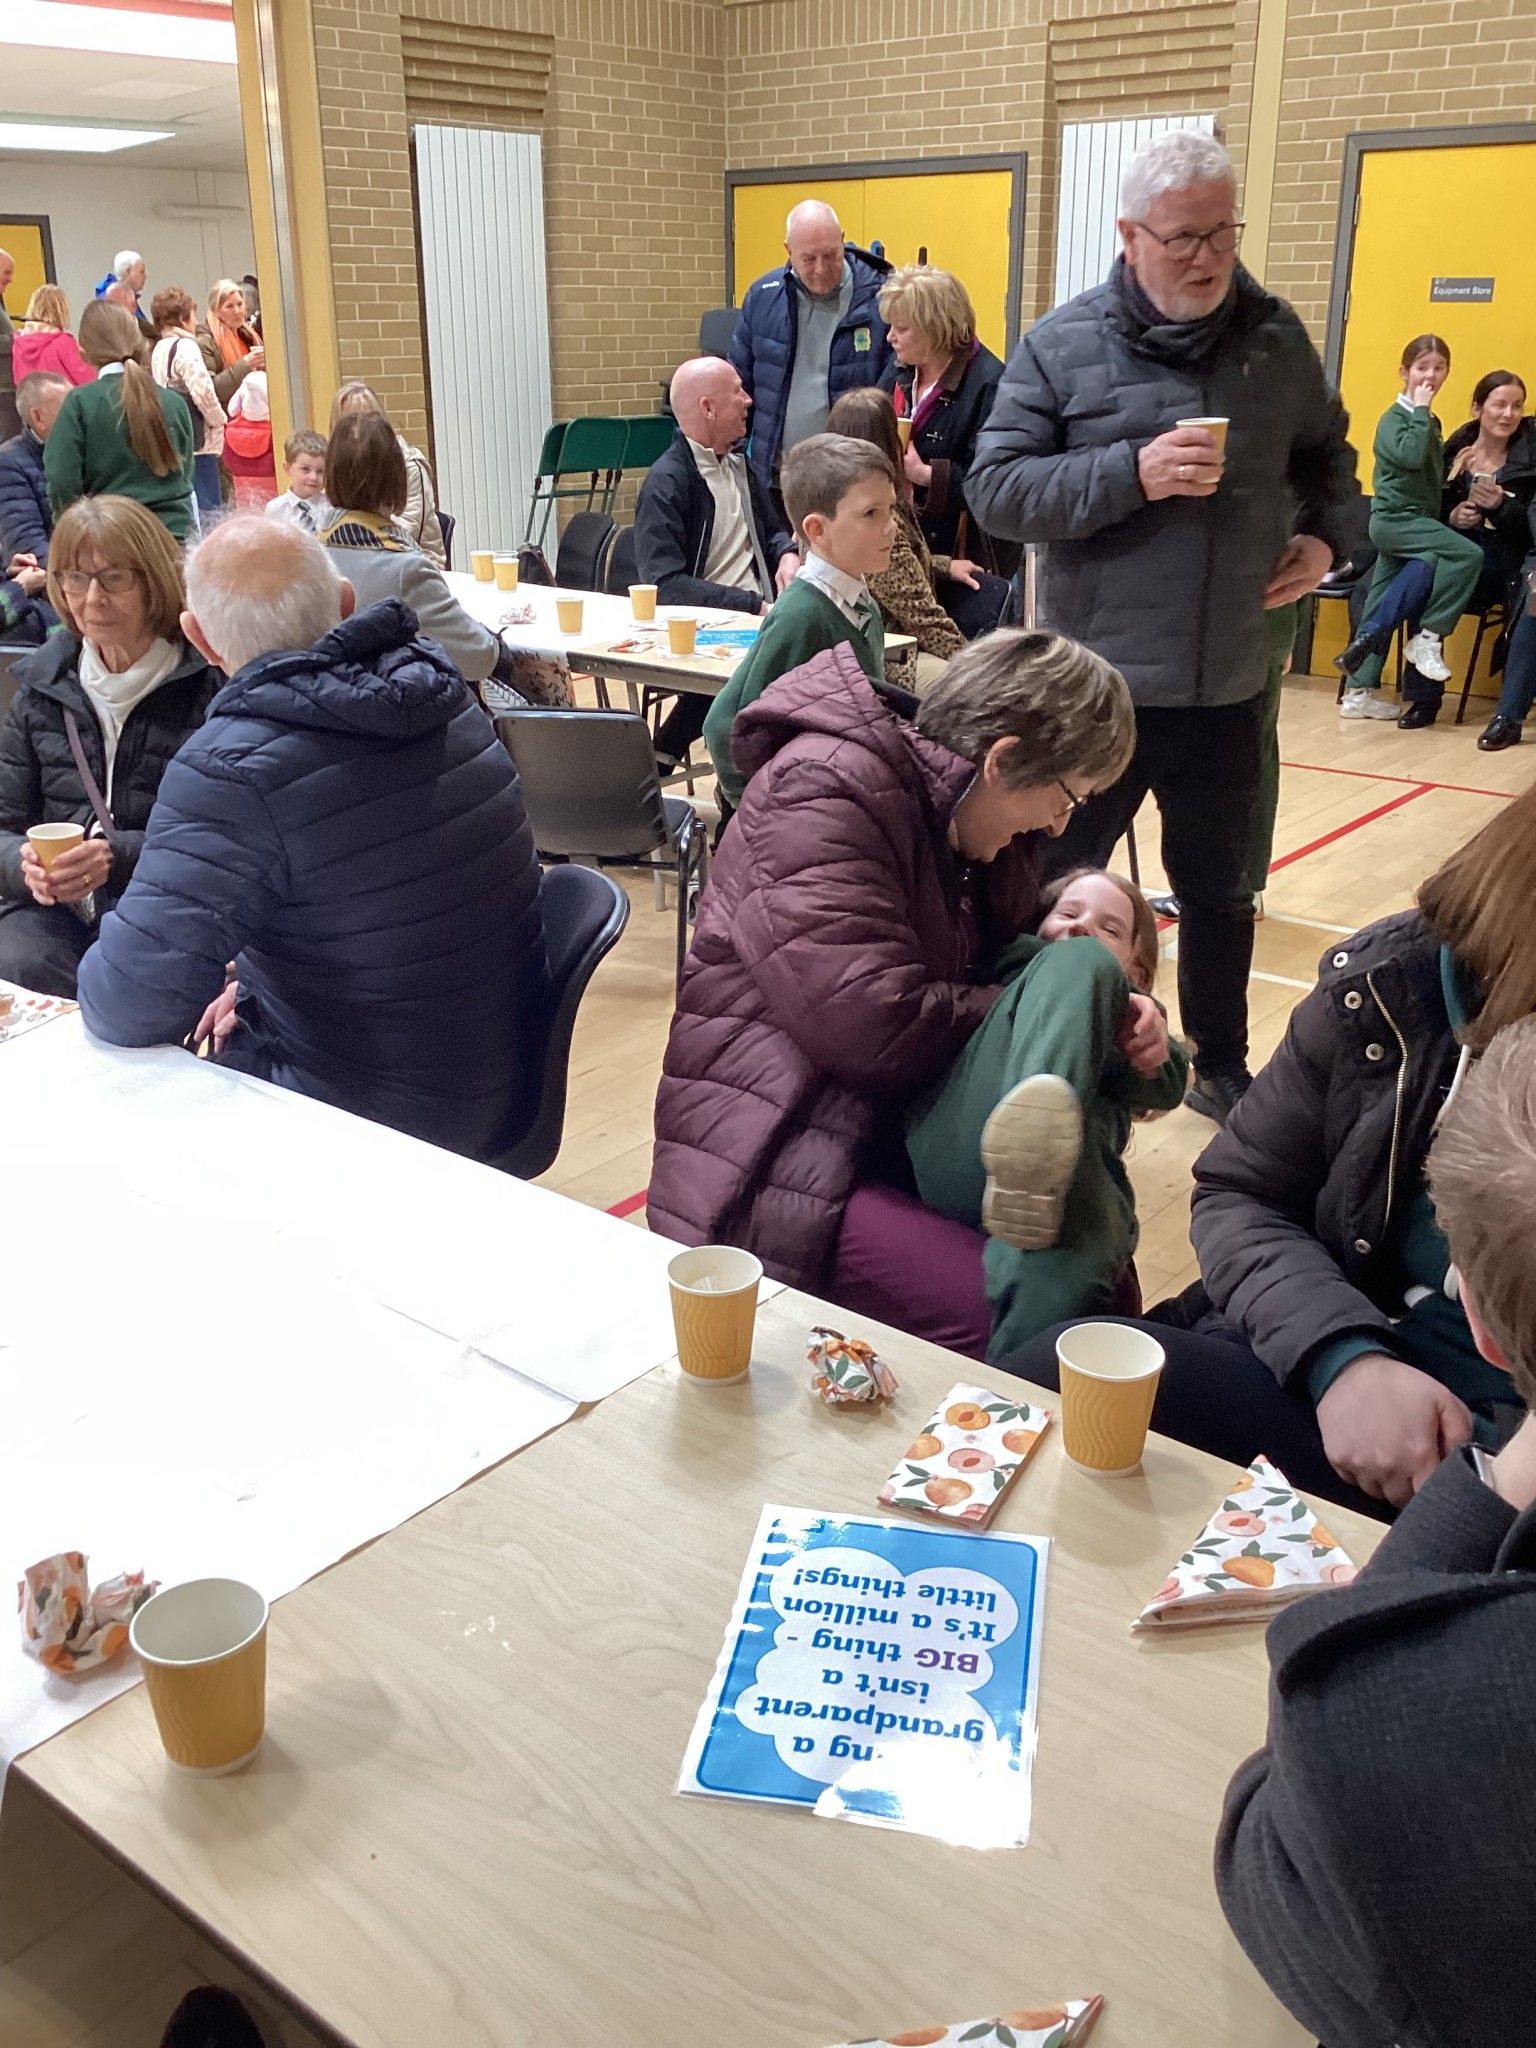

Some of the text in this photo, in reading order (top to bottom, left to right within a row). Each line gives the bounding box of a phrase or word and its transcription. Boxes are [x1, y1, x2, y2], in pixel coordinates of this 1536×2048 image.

[1433, 286, 1491, 296] Equipment Store
[793, 1567, 997, 1613] little things!
[783, 1596, 997, 1643] It's a million
[811, 1628, 902, 1663] thing
[914, 1648, 979, 1674] BIG
[822, 1669, 930, 1704] isn't a
[754, 1696, 985, 1743] grandparent
[793, 1736, 815, 1753] a
